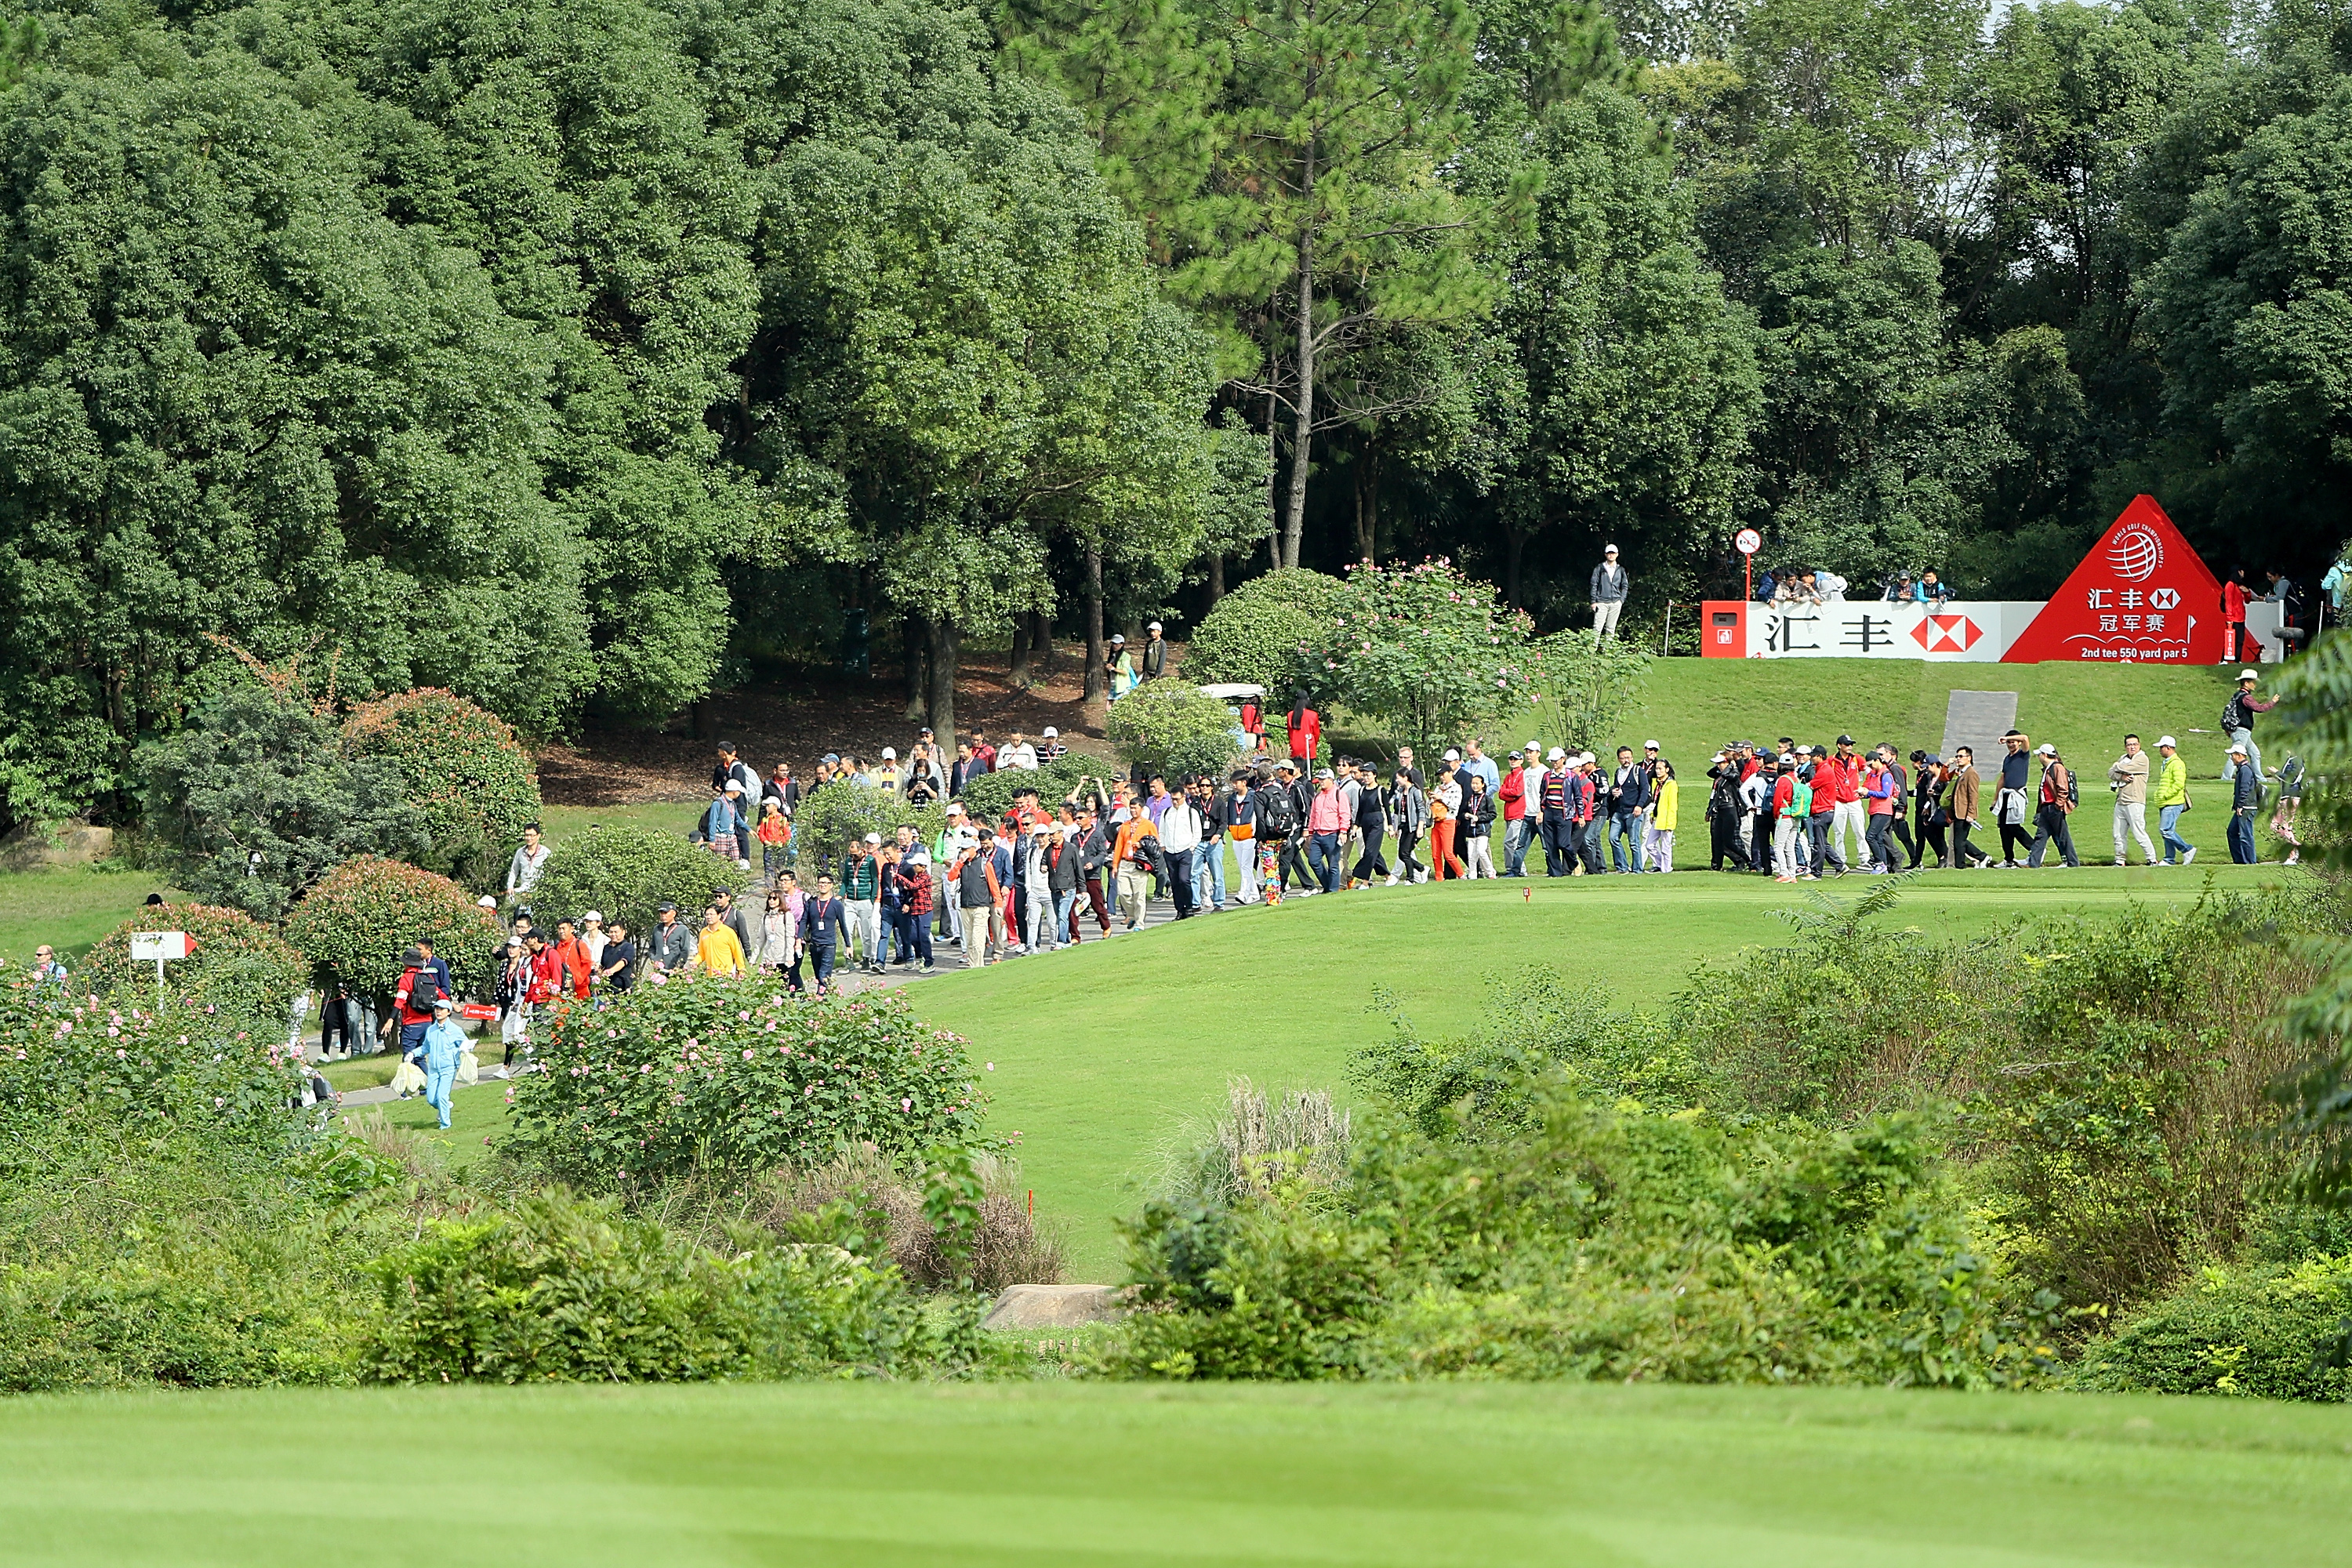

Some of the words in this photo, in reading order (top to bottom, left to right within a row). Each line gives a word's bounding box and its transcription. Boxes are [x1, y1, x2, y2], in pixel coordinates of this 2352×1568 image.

[2111, 528, 2127, 546] WORLD
[2141, 524, 2164, 564] CHAMPIONSHIPS
[2087, 588, 2143, 609] 汇丰
[1764, 614, 1894, 652] 汇丰
[2099, 614, 2165, 633] 冠军赛
[2082, 648, 2100, 658] 2nd
[2102, 649, 2118, 658] tee
[2119, 648, 2137, 658] 550
[2139, 648, 2161, 660] yard
[2163, 650, 2180, 660] par
[2181, 648, 2188, 658] 5
